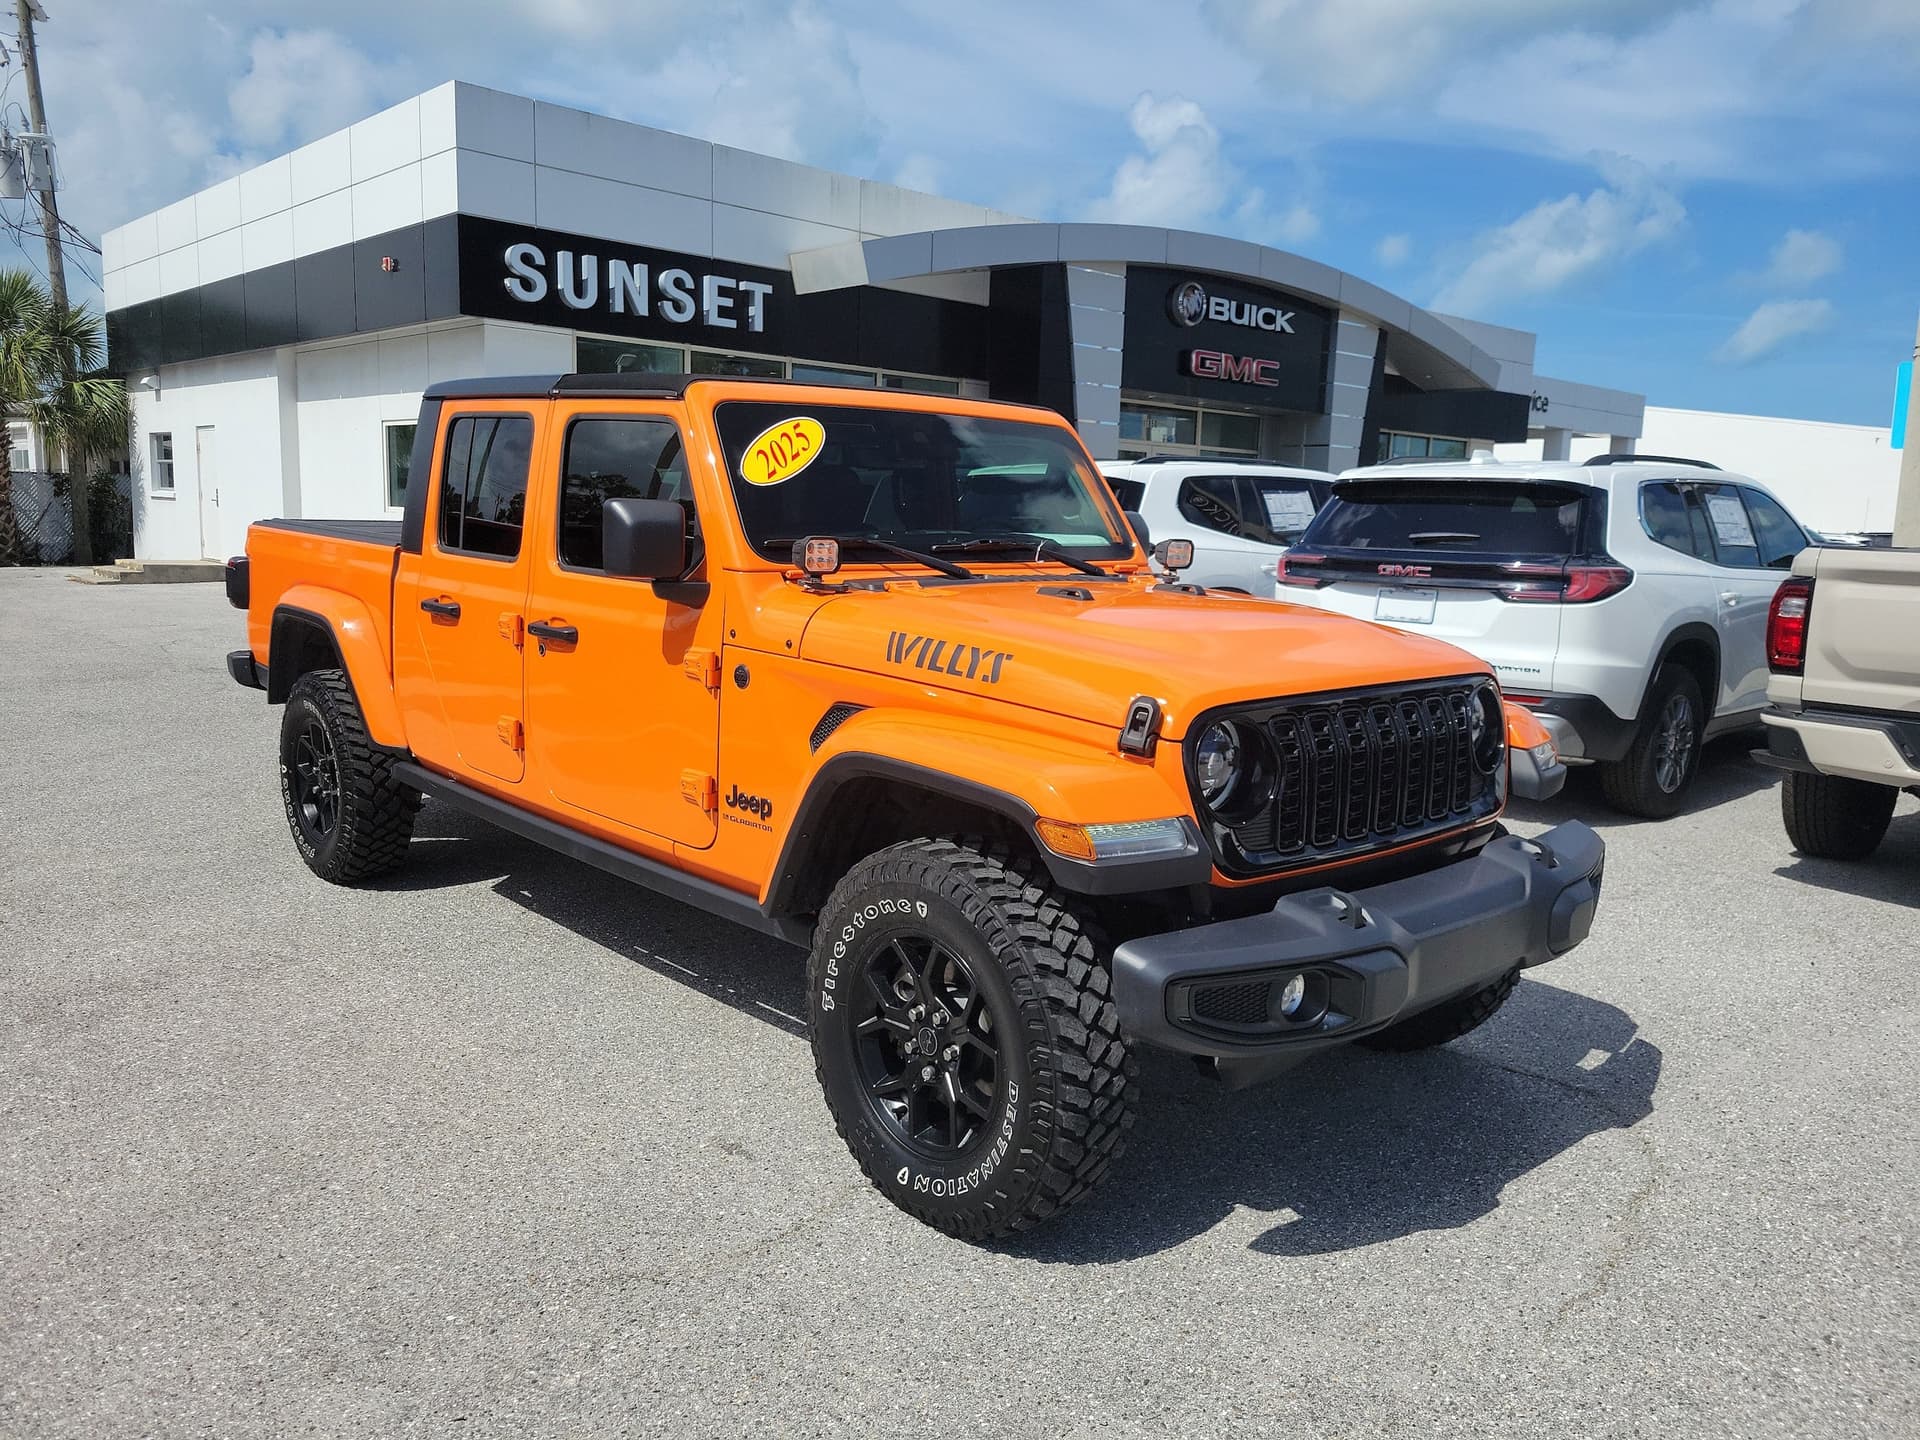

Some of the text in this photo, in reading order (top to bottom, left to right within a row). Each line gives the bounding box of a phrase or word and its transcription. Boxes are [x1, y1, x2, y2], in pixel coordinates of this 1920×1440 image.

[504, 242, 773, 333] SUNSET
[1208, 296, 1296, 334] BUICK
[1191, 349, 1280, 387] GMC
[1530, 389, 1549, 413] ice
[756, 422, 811, 480] 2025
[1377, 564, 1433, 578] GMC
[886, 631, 1015, 684] WILLYS
[725, 783, 773, 822] Jeep
[821, 898, 912, 1012] Firestone
[914, 1080, 1020, 1197] DESTINATION
